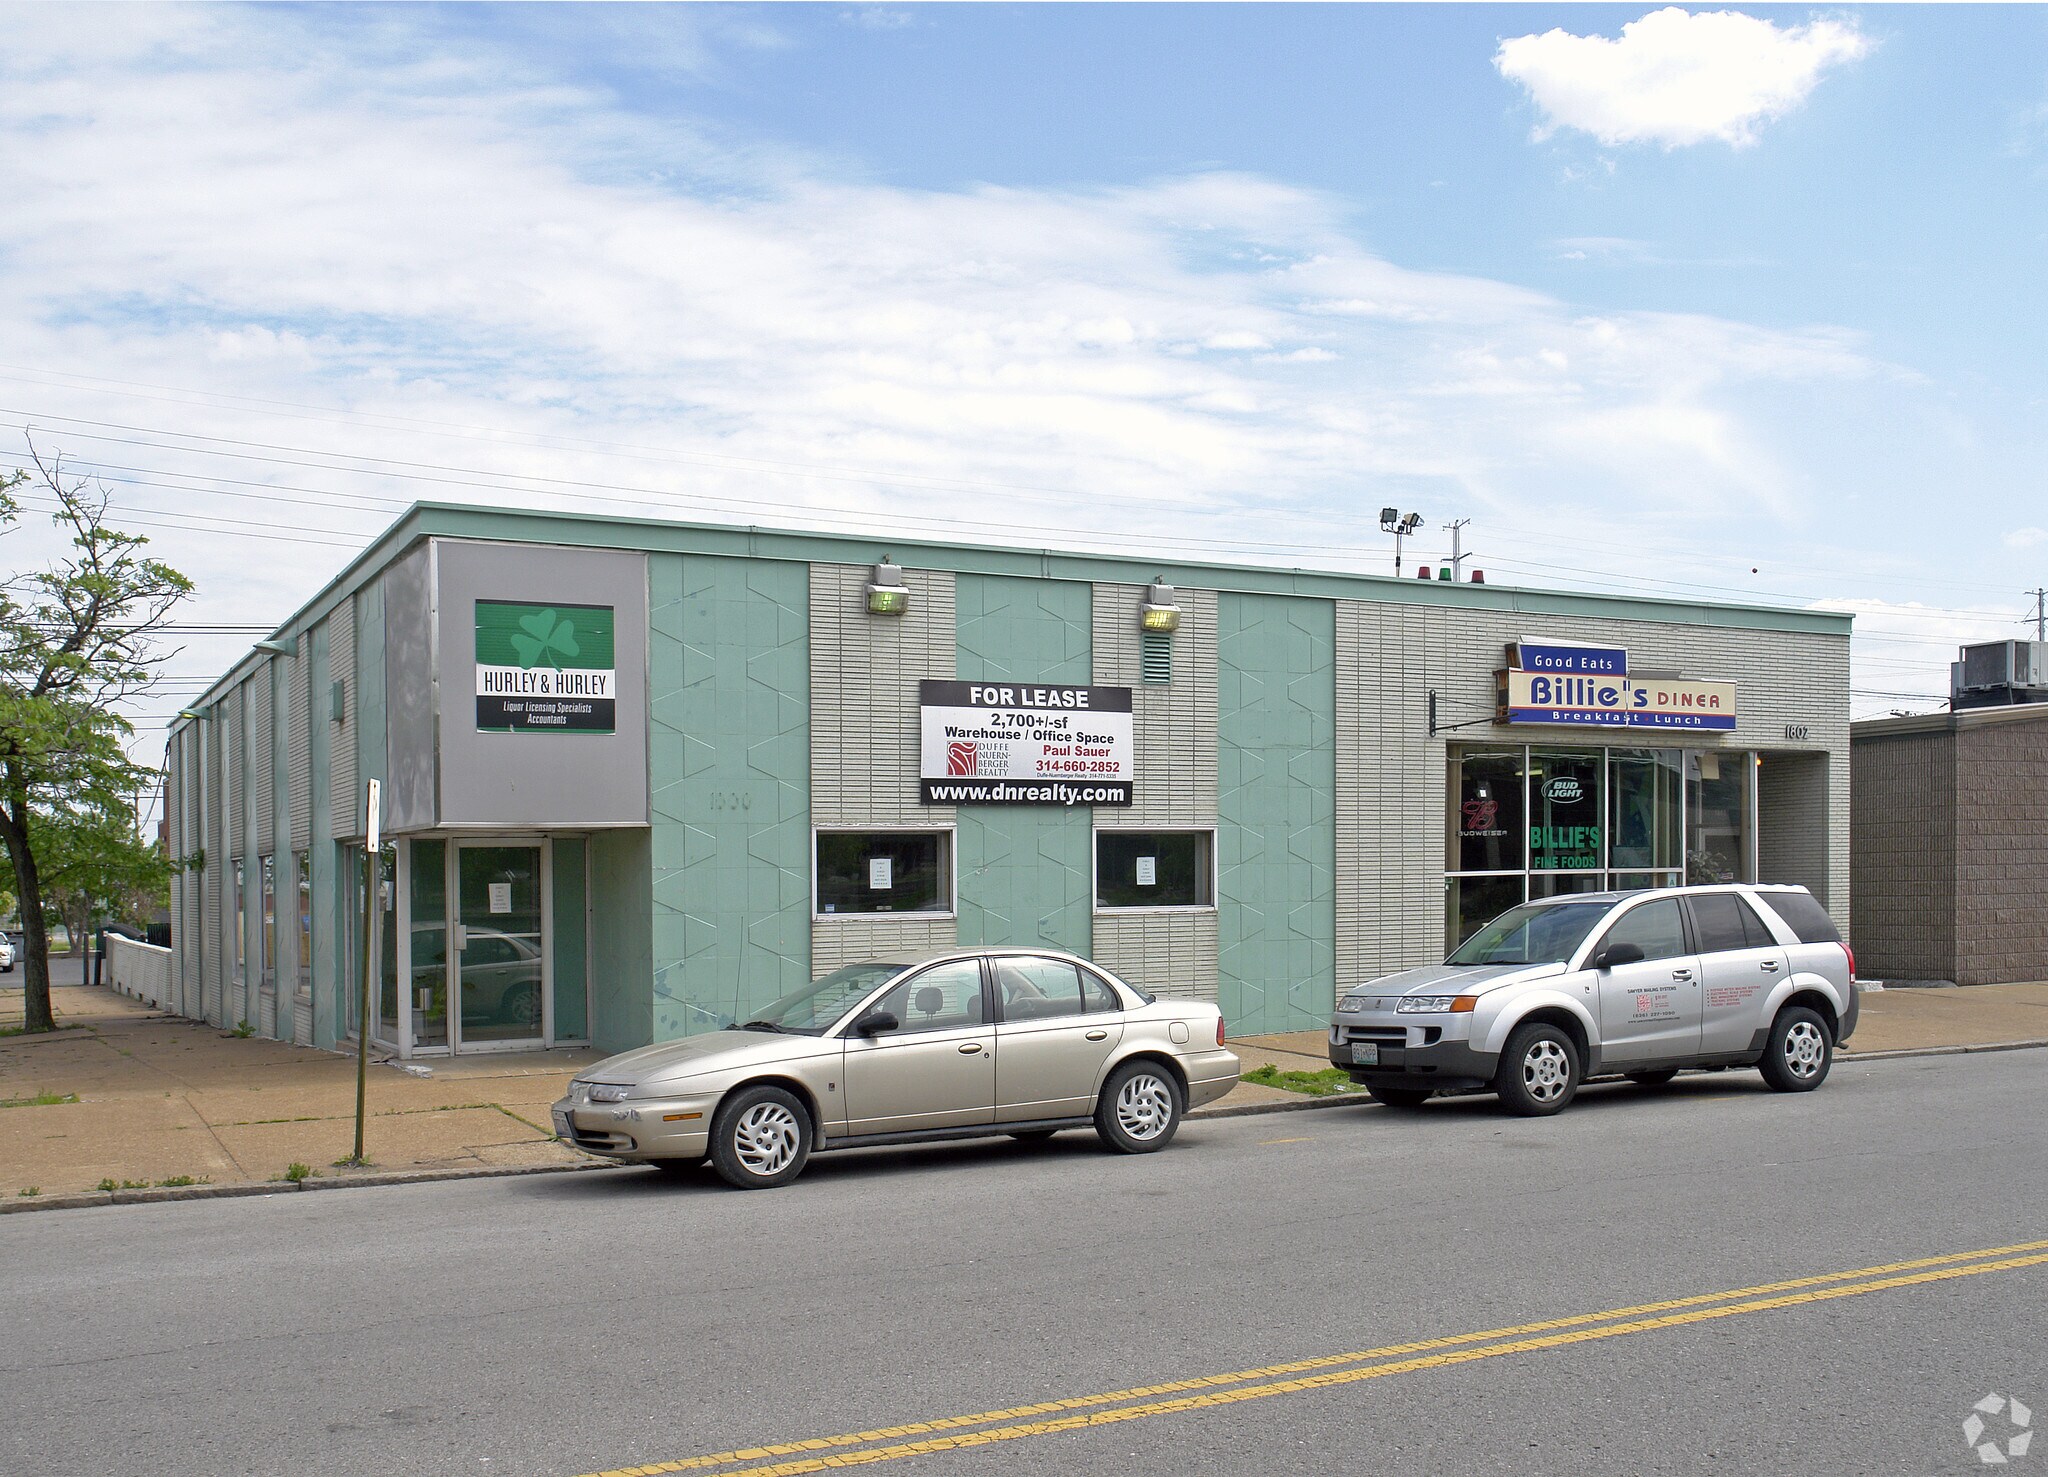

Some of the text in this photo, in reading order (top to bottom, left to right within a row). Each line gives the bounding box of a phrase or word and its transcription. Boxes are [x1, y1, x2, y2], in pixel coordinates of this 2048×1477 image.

[1535, 655, 1613, 670] Good Eats
[484, 671, 606, 695] HURLEY & HURLEY
[970, 686, 1090, 708] FOR LEASE
[1530, 676, 1720, 708] Billie's DINER
[503, 701, 593, 714] Liquor Licensing Specialists
[527, 714, 567, 725] Accountants
[990, 712, 1069, 730] 2,700+/-sf
[1552, 711, 1702, 725] Breakfast Lunch
[944, 726, 1115, 746] Warehouse / Office Space
[1785, 724, 1808, 740] 1802
[978, 742, 1009, 751] DUFFE
[1043, 744, 1111, 758] Paul Sauer
[978, 760, 1009, 768] BERGER
[1035, 760, 1120, 773] 314-660-2852
[978, 768, 1009, 777] REALTY
[1553, 782, 1579, 790] BUD
[930, 783, 1125, 806] www.dnrealty.com
[1548, 789, 1584, 798] LIGHT
[1530, 826, 1600, 849] BILLIE'S
[1534, 856, 1596, 869] FINE FOODS
